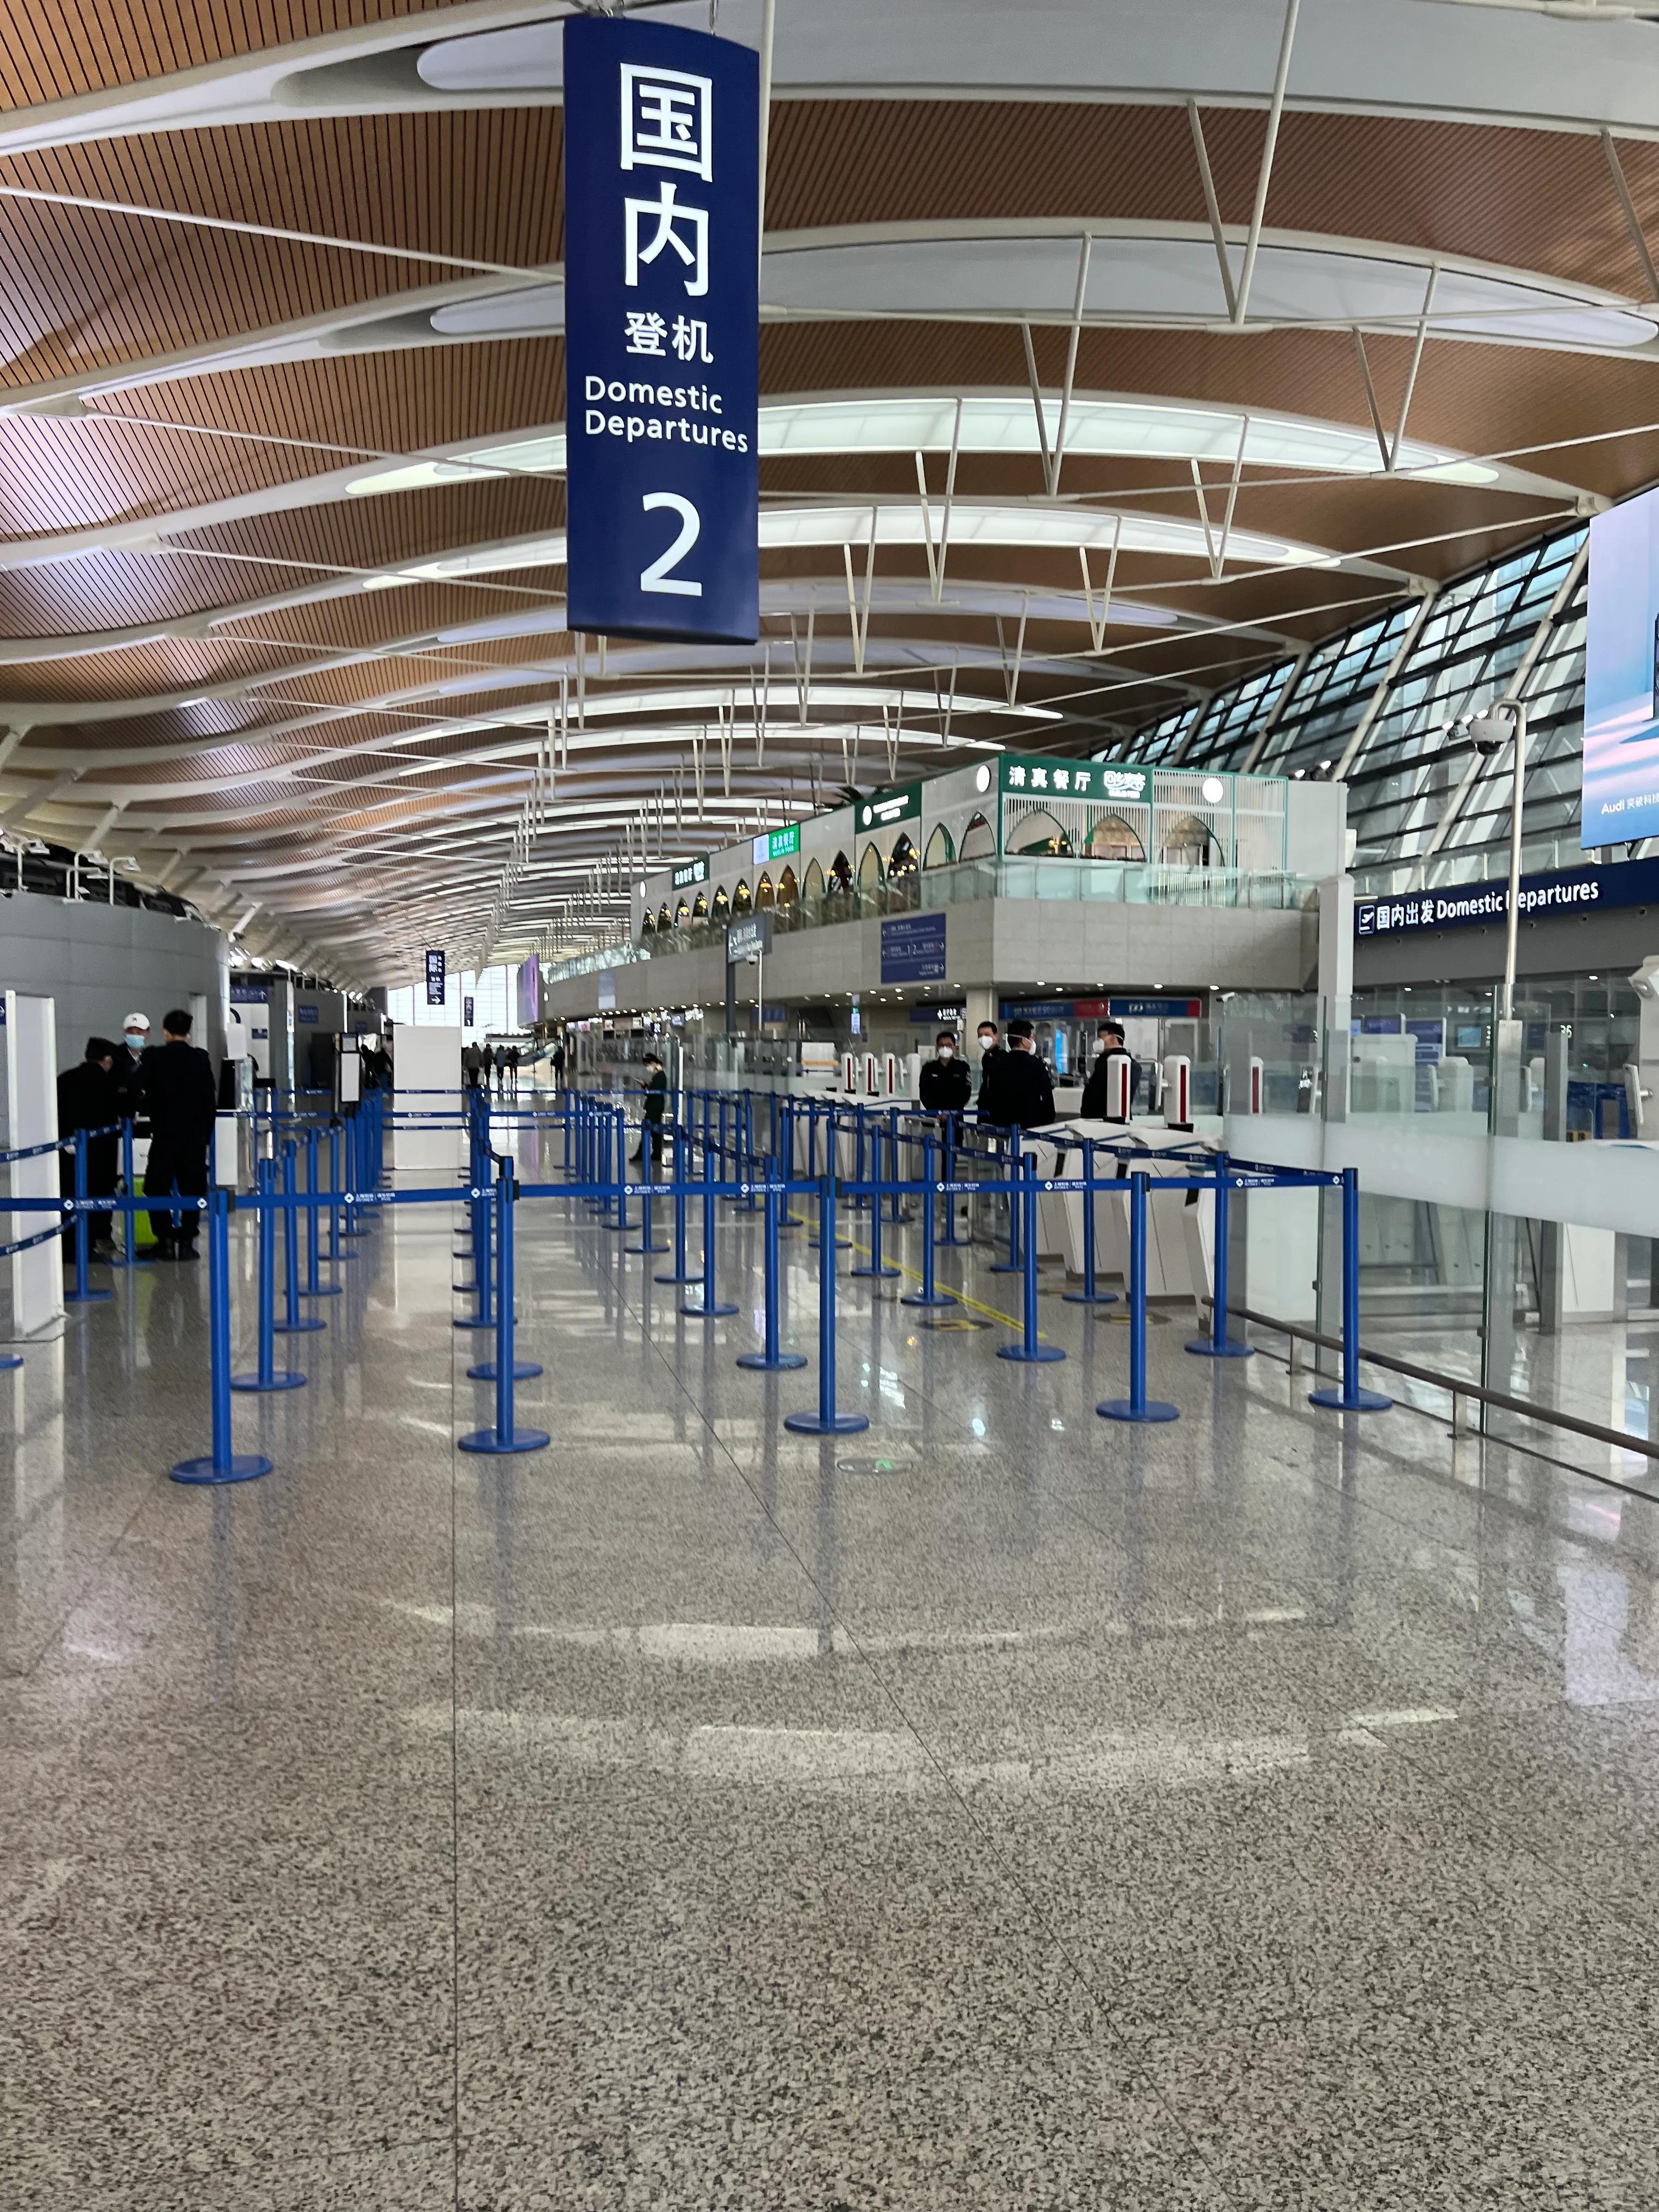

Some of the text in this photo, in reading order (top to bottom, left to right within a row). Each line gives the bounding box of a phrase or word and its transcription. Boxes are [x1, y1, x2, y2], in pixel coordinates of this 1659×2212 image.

[620, 63, 712, 296] 国内
[624, 312, 714, 363] 登机
[585, 376, 723, 414] Domestic
[585, 410, 748, 453] Departures
[641, 492, 702, 597] 2
[1009, 765, 1091, 792] 清真餐厅
[1601, 799, 1625, 815] Audi
[1376, 899, 1434, 930] 国内出发
[1437, 891, 1503, 919] Domestic
